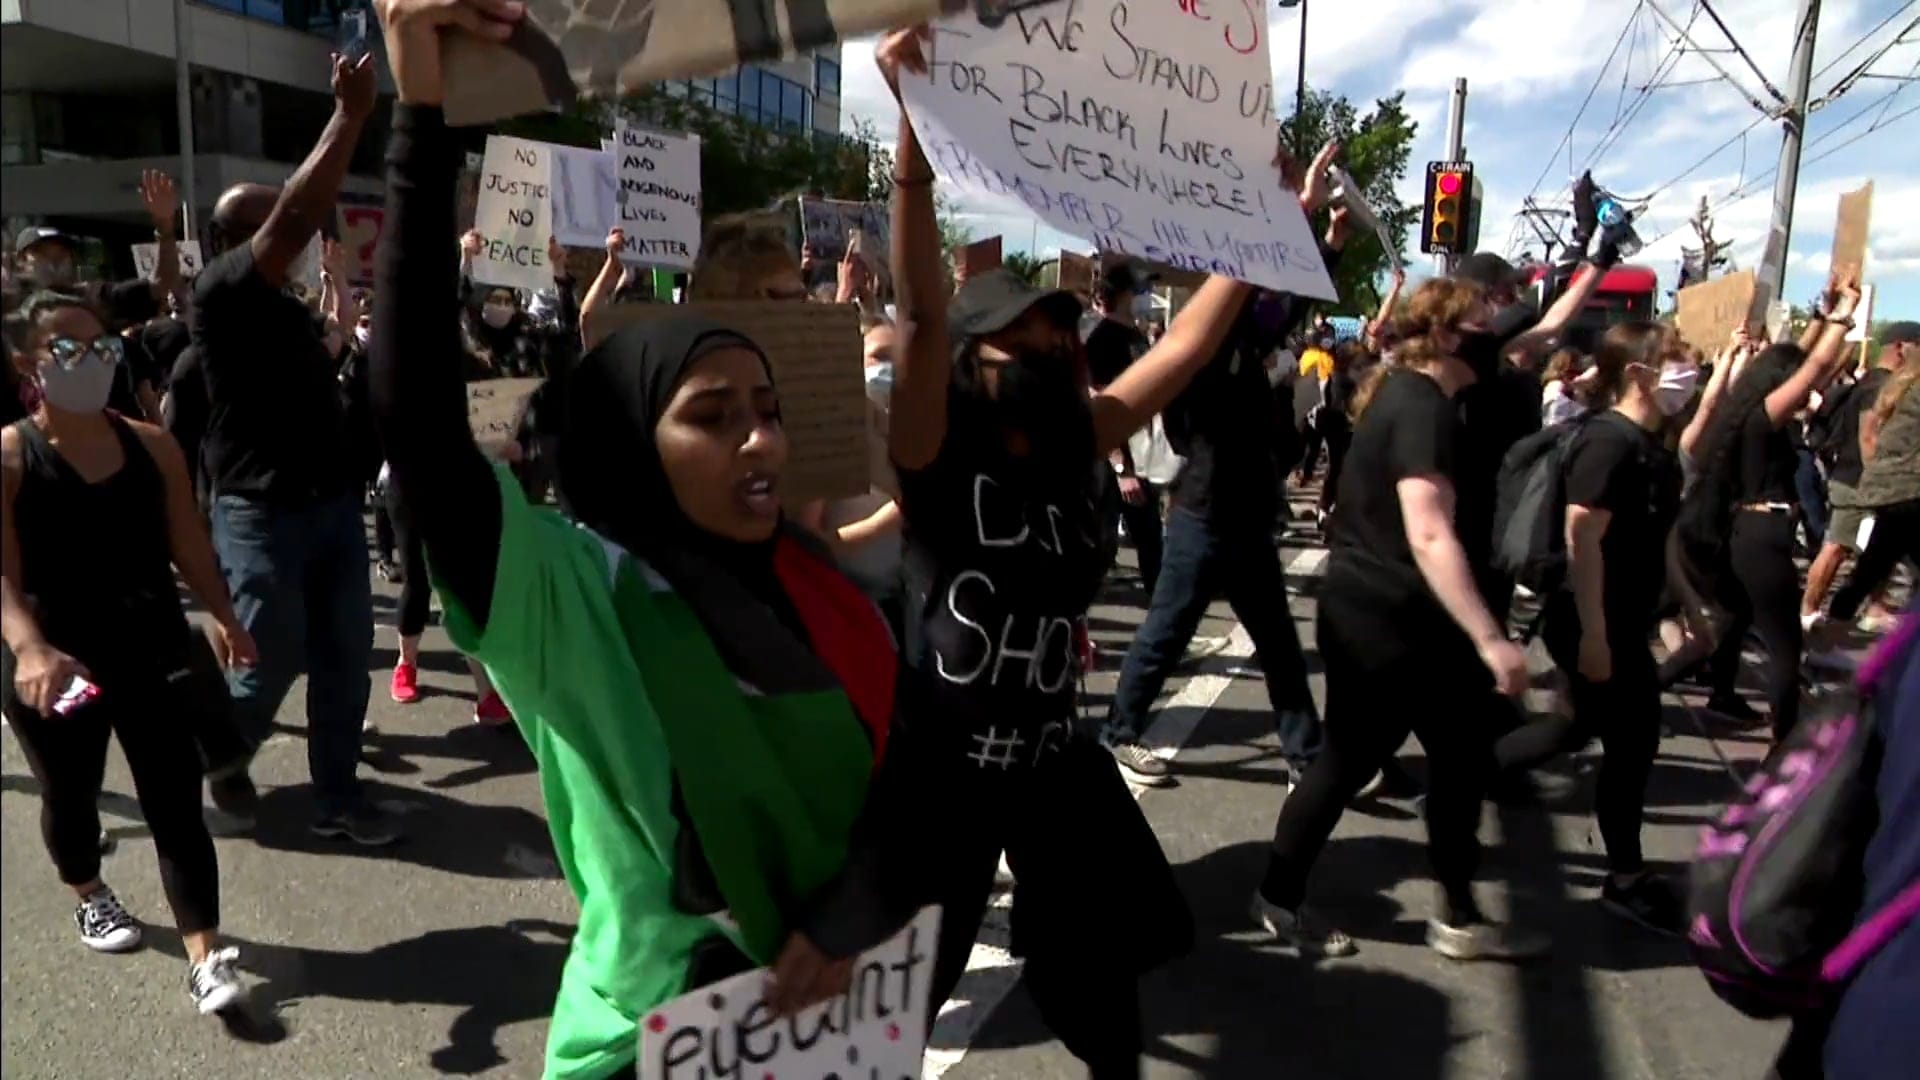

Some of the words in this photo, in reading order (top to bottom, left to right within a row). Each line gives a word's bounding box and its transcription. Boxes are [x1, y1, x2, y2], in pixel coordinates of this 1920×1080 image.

[1102, 2, 1220, 103] STAND
[927, 27, 1003, 104] FOR
[1007, 62, 1137, 150] BLACK
[1159, 108, 1244, 181] LIVES
[623, 129, 667, 152] BLACK
[514, 147, 537, 167] NO
[623, 154, 655, 172] AND
[1010, 118, 1272, 224] EVERYWHERE!
[1430, 162, 1471, 173] C-TRAIN
[507, 208, 534, 227] NO
[622, 205, 666, 222] LIVES
[623, 236, 690, 257] MATTER
